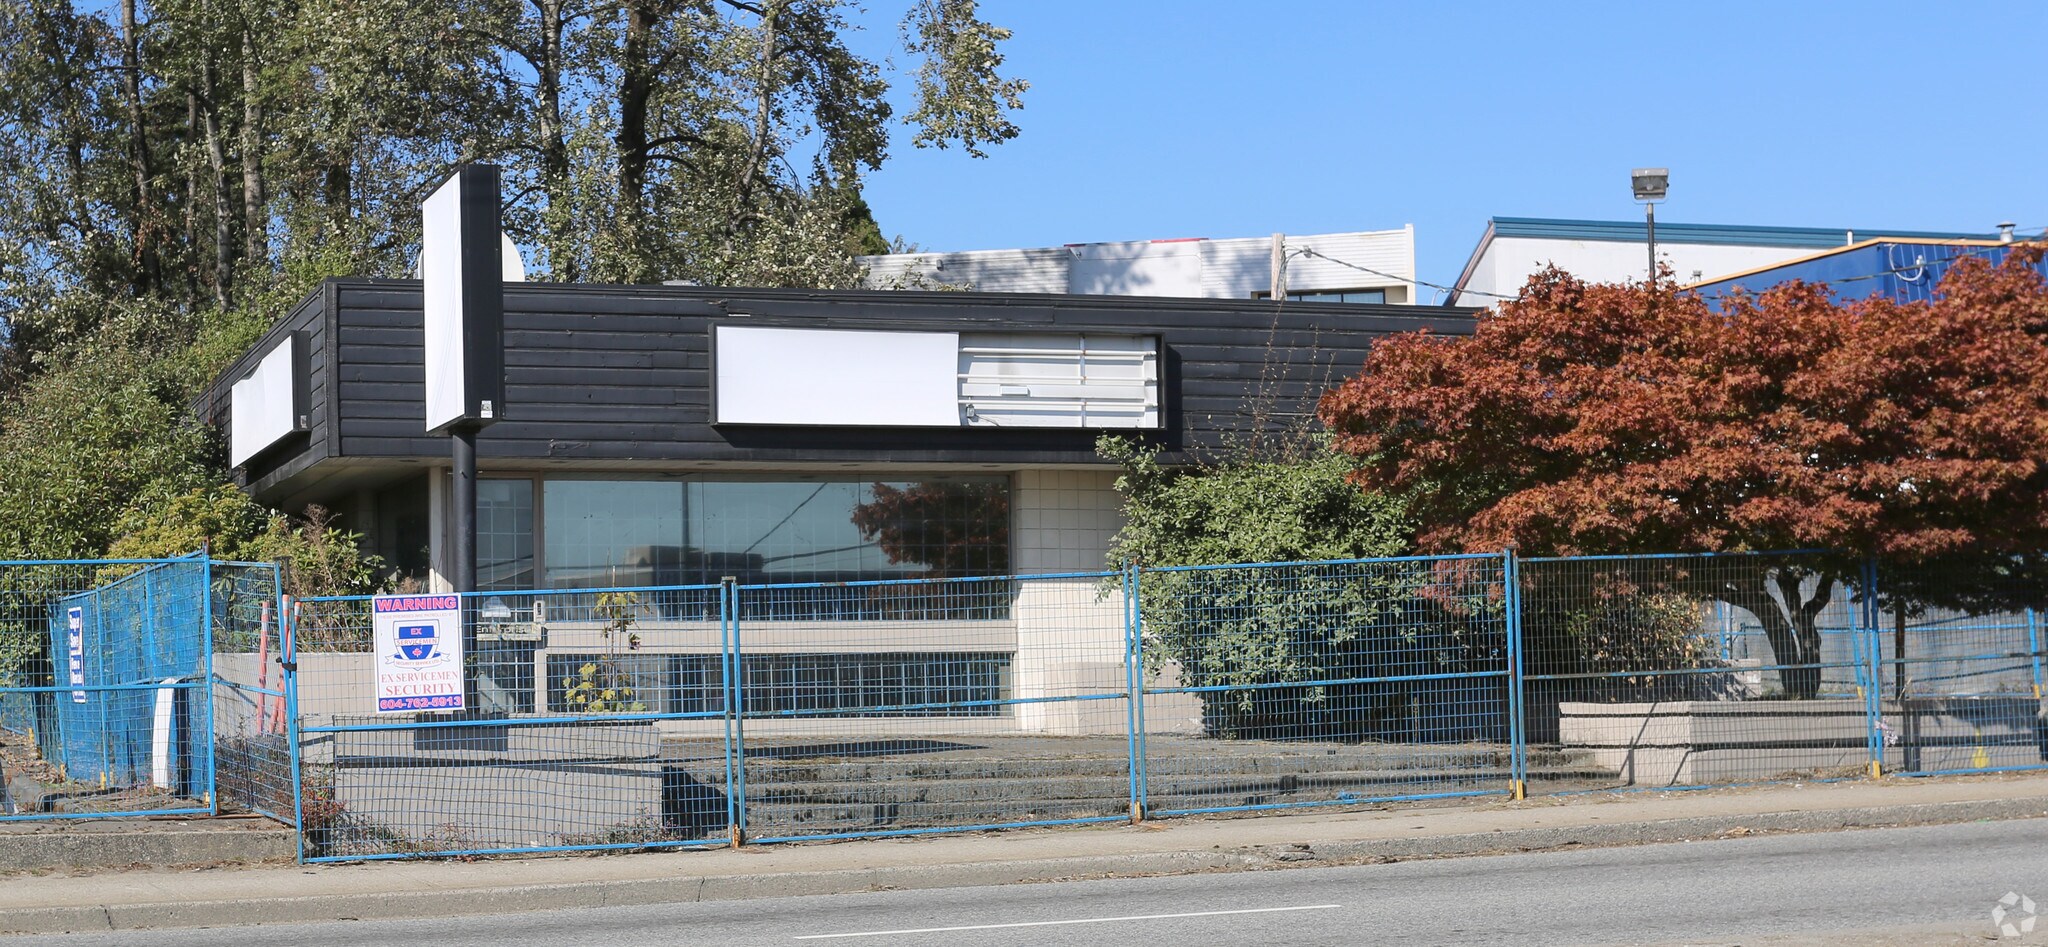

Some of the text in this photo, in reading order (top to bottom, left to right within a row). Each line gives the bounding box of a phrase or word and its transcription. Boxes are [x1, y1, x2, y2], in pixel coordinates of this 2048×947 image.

[376, 597, 457, 611] WARNING
[410, 627, 422, 635] EX
[381, 671, 458, 683] EX SERVICEMEN
[385, 683, 456, 696] SECURITY
[380, 696, 462, 710] 604-762-5913
